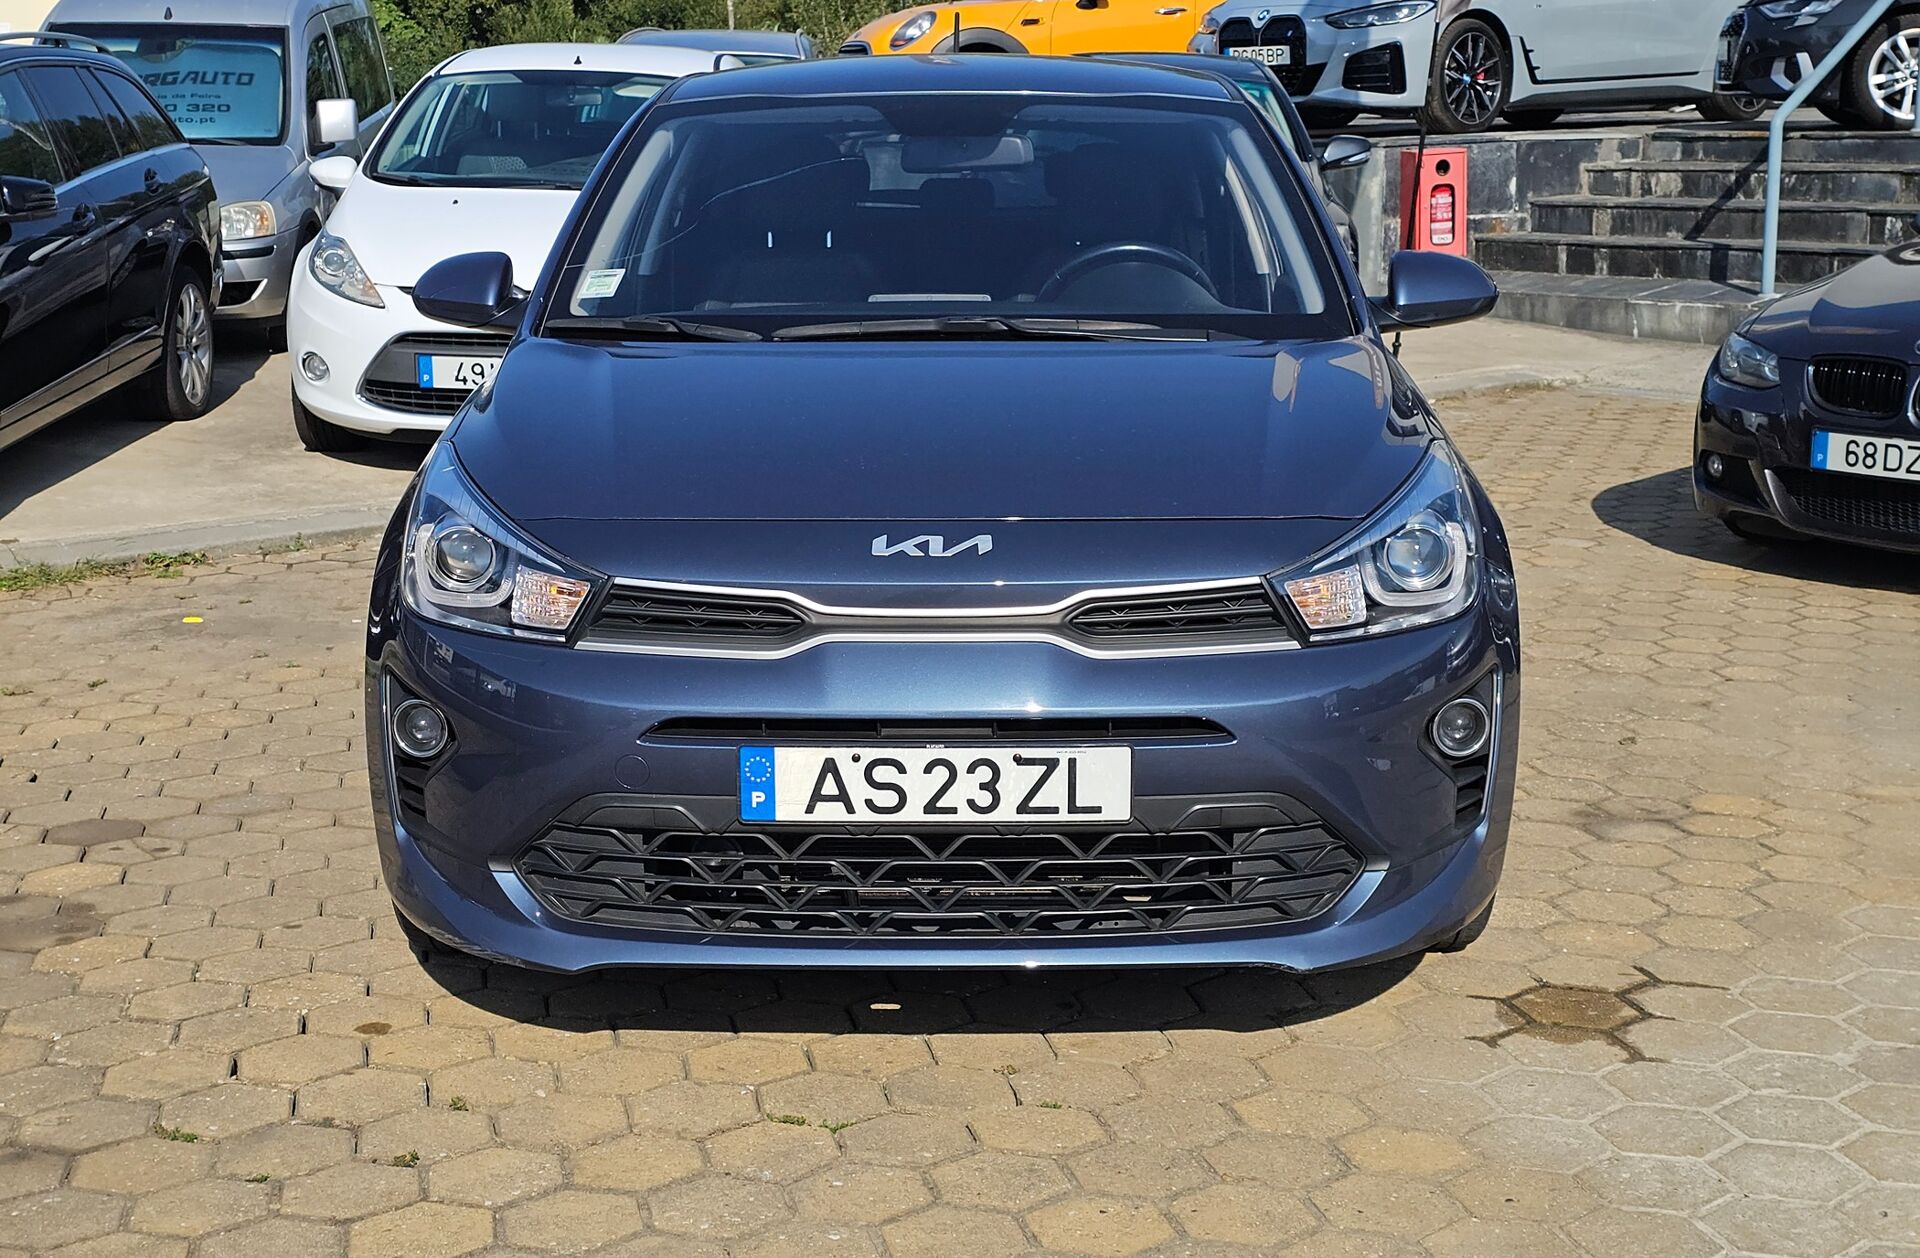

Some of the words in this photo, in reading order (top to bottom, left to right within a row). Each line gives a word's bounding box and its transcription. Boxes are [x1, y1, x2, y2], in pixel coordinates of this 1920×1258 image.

[139, 71, 255, 86] RGAUTO
[186, 103, 231, 112] 320
[423, 374, 430, 382] P
[455, 362, 494, 385] 49
[872, 534, 993, 557] KIA
[751, 791, 766, 808] P
